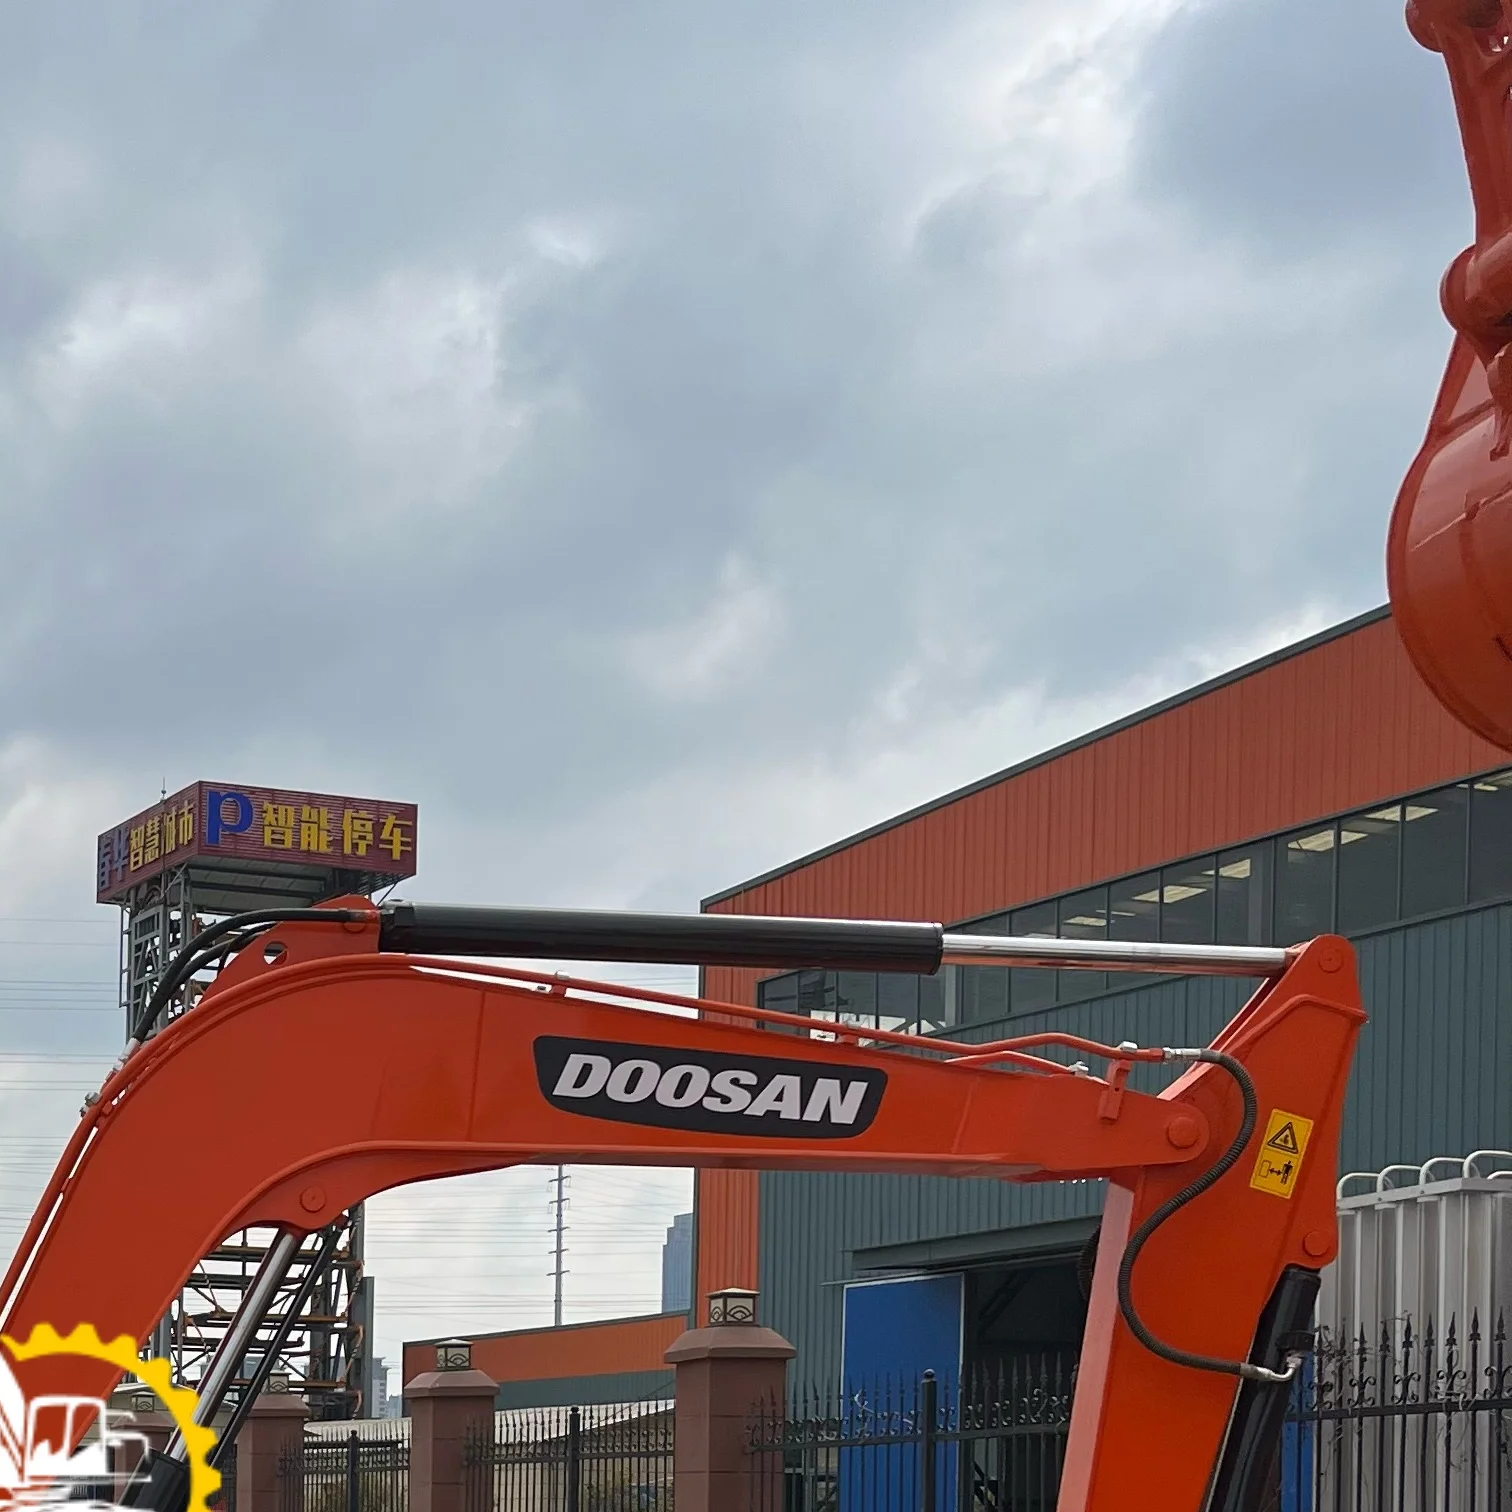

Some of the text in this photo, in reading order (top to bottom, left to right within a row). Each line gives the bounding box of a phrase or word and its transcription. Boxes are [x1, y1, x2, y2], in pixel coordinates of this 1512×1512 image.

[261, 801, 413, 861] 智能停车
[552, 1053, 869, 1125] DOOSAN
